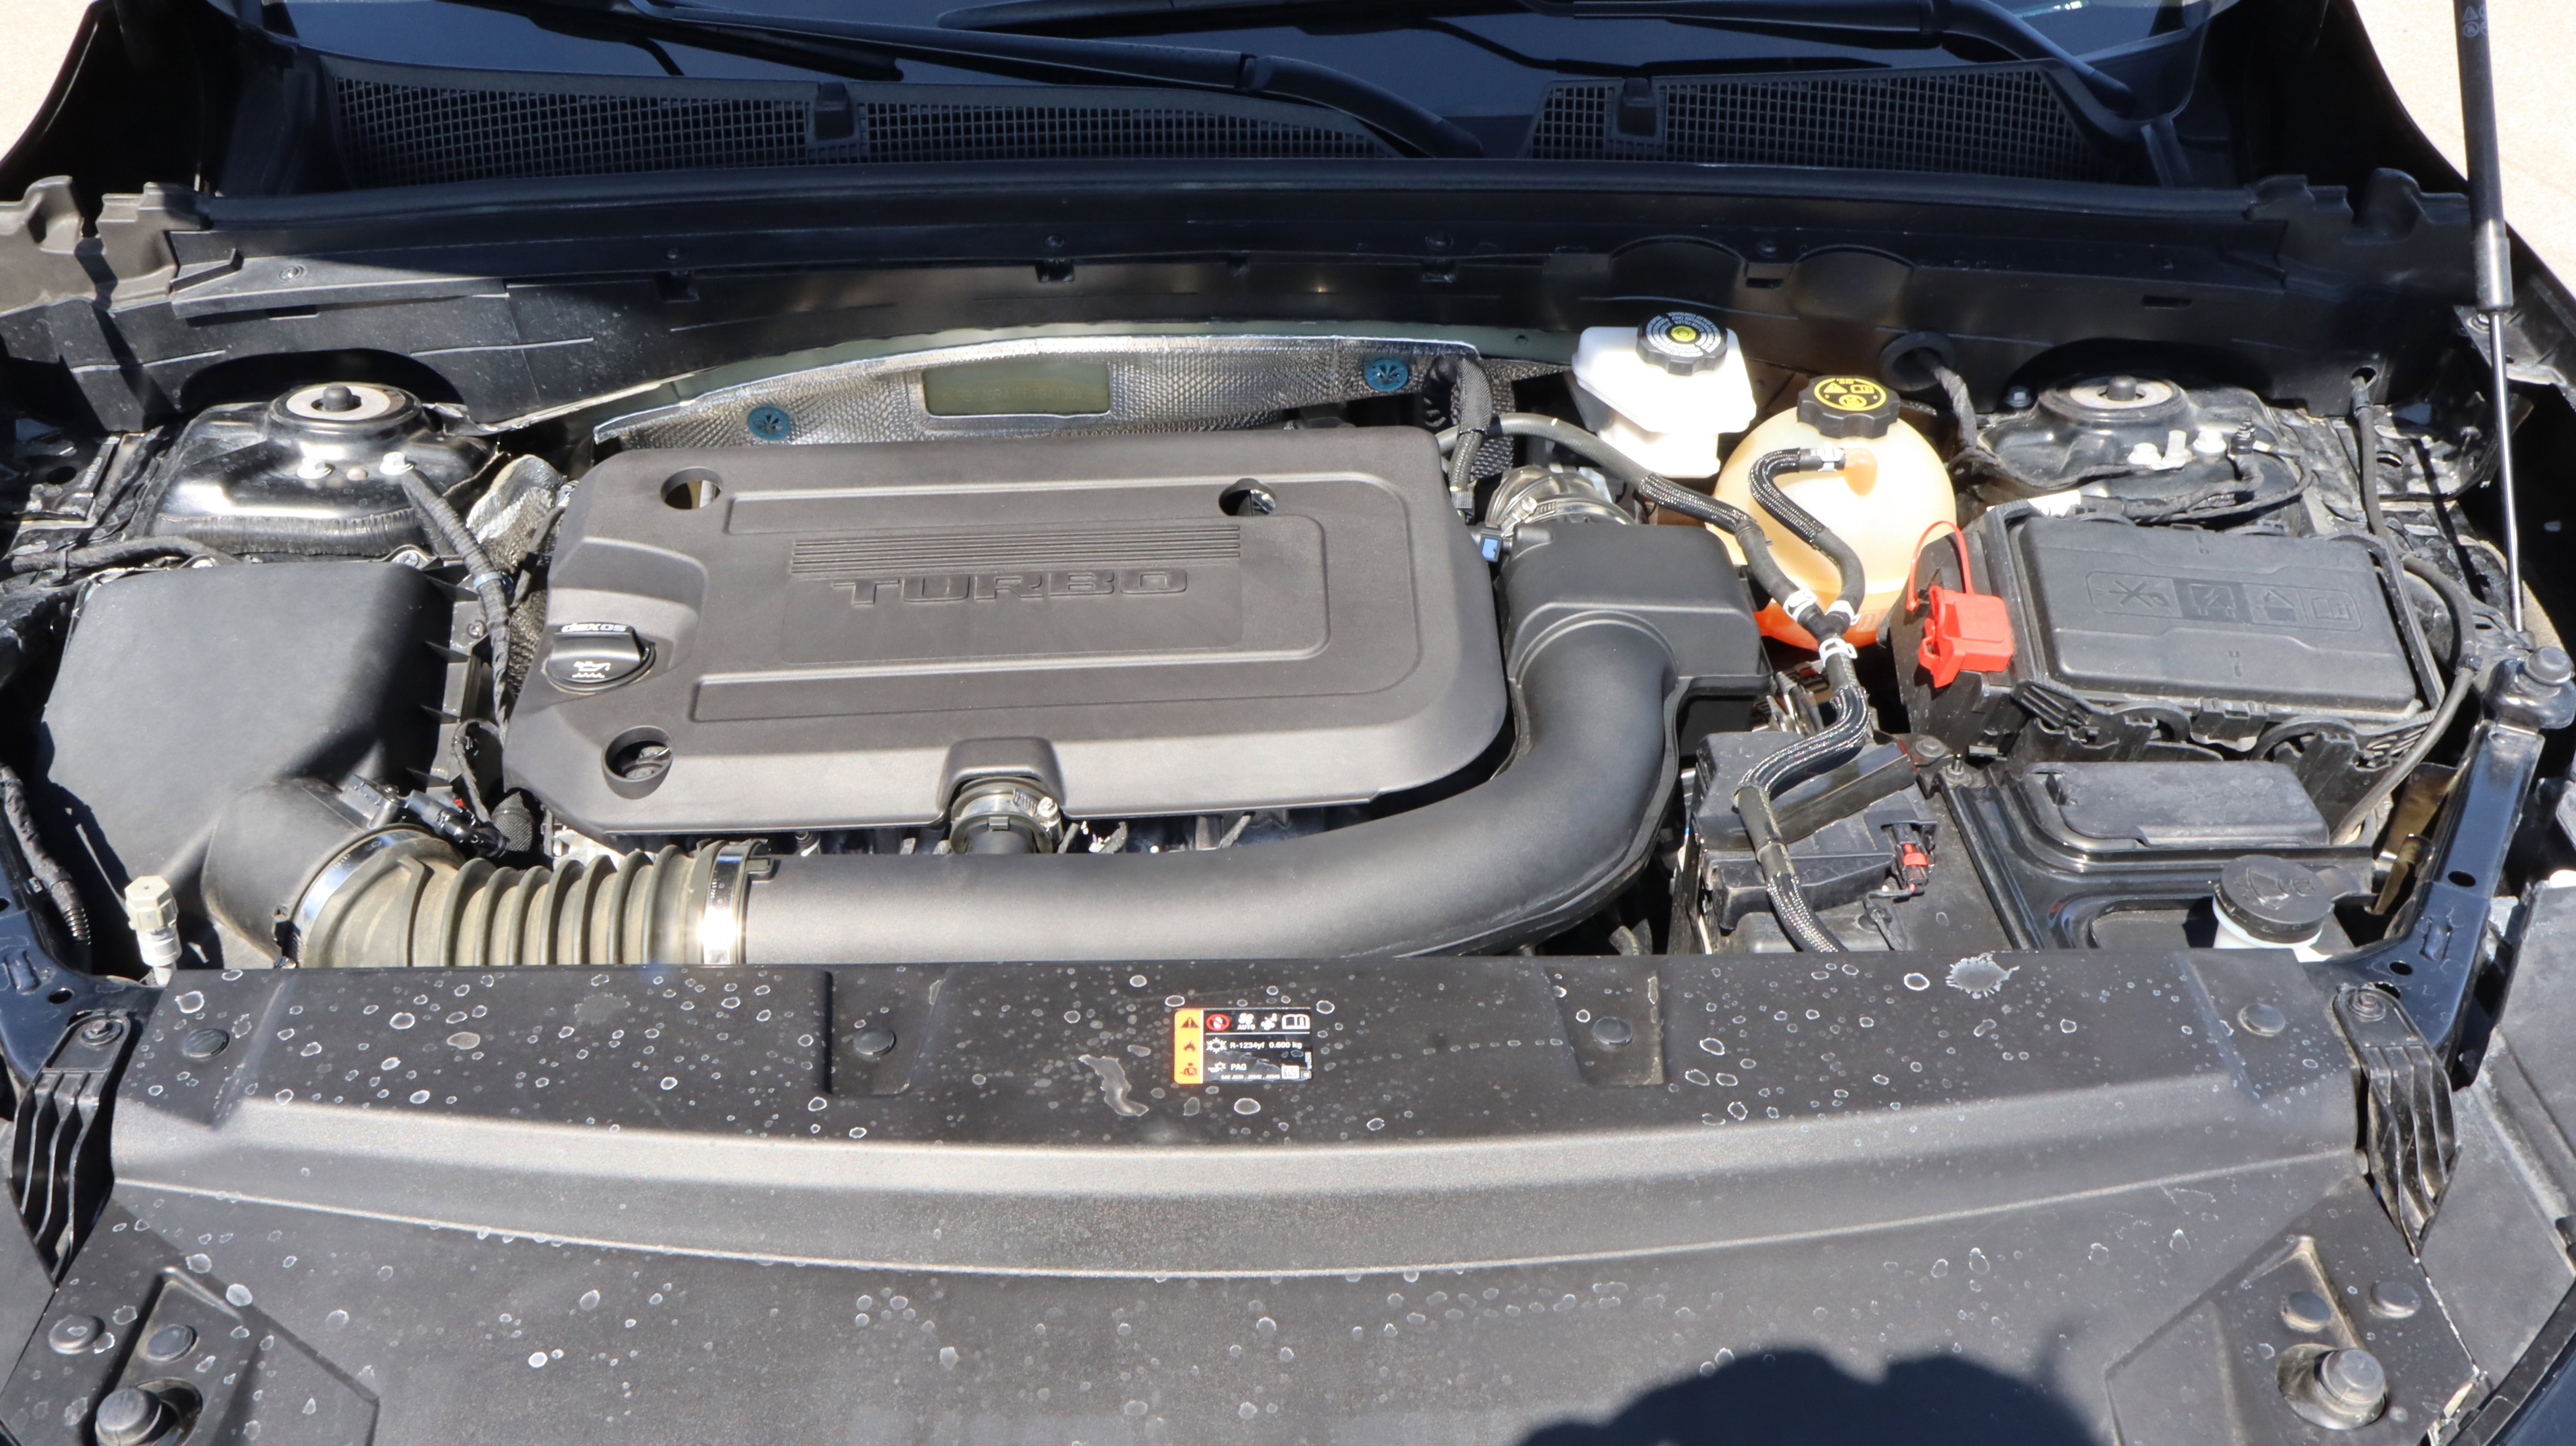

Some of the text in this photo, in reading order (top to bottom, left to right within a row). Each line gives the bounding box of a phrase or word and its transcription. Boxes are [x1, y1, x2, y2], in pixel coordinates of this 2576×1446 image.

[832, 568, 1188, 605] TURBO
[561, 623, 627, 632] dexos
[1230, 1042, 1265, 1050] R-1234yf
[1292, 1041, 1302, 1050] kg
